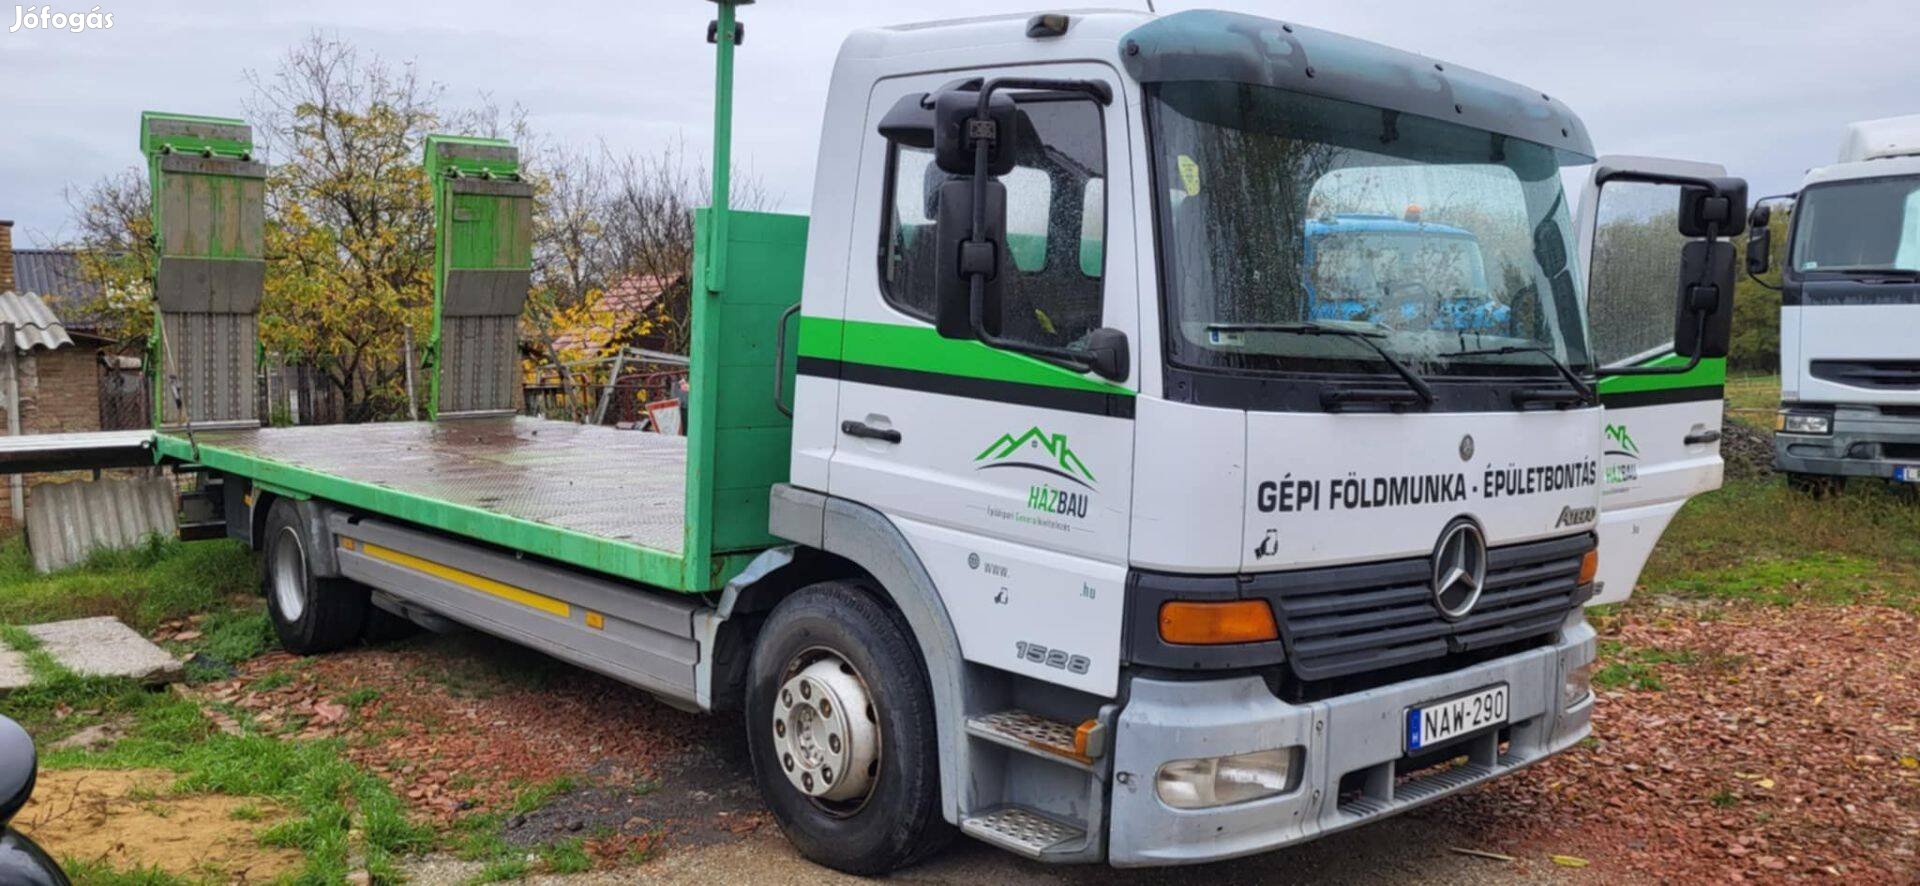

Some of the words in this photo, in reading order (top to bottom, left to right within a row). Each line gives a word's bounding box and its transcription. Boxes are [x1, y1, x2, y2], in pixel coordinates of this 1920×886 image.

[1027, 483, 1089, 519] HÁZBAU
[1257, 472, 1320, 513] GÉPI
[1330, 472, 1467, 510] FÖLDMUNKA
[1483, 454, 1597, 499] ÉPÜLETBONTÁS
[1080, 581, 1096, 600] .hu
[1016, 641, 1092, 675] 1528
[1424, 690, 1504, 741] NAW-290
